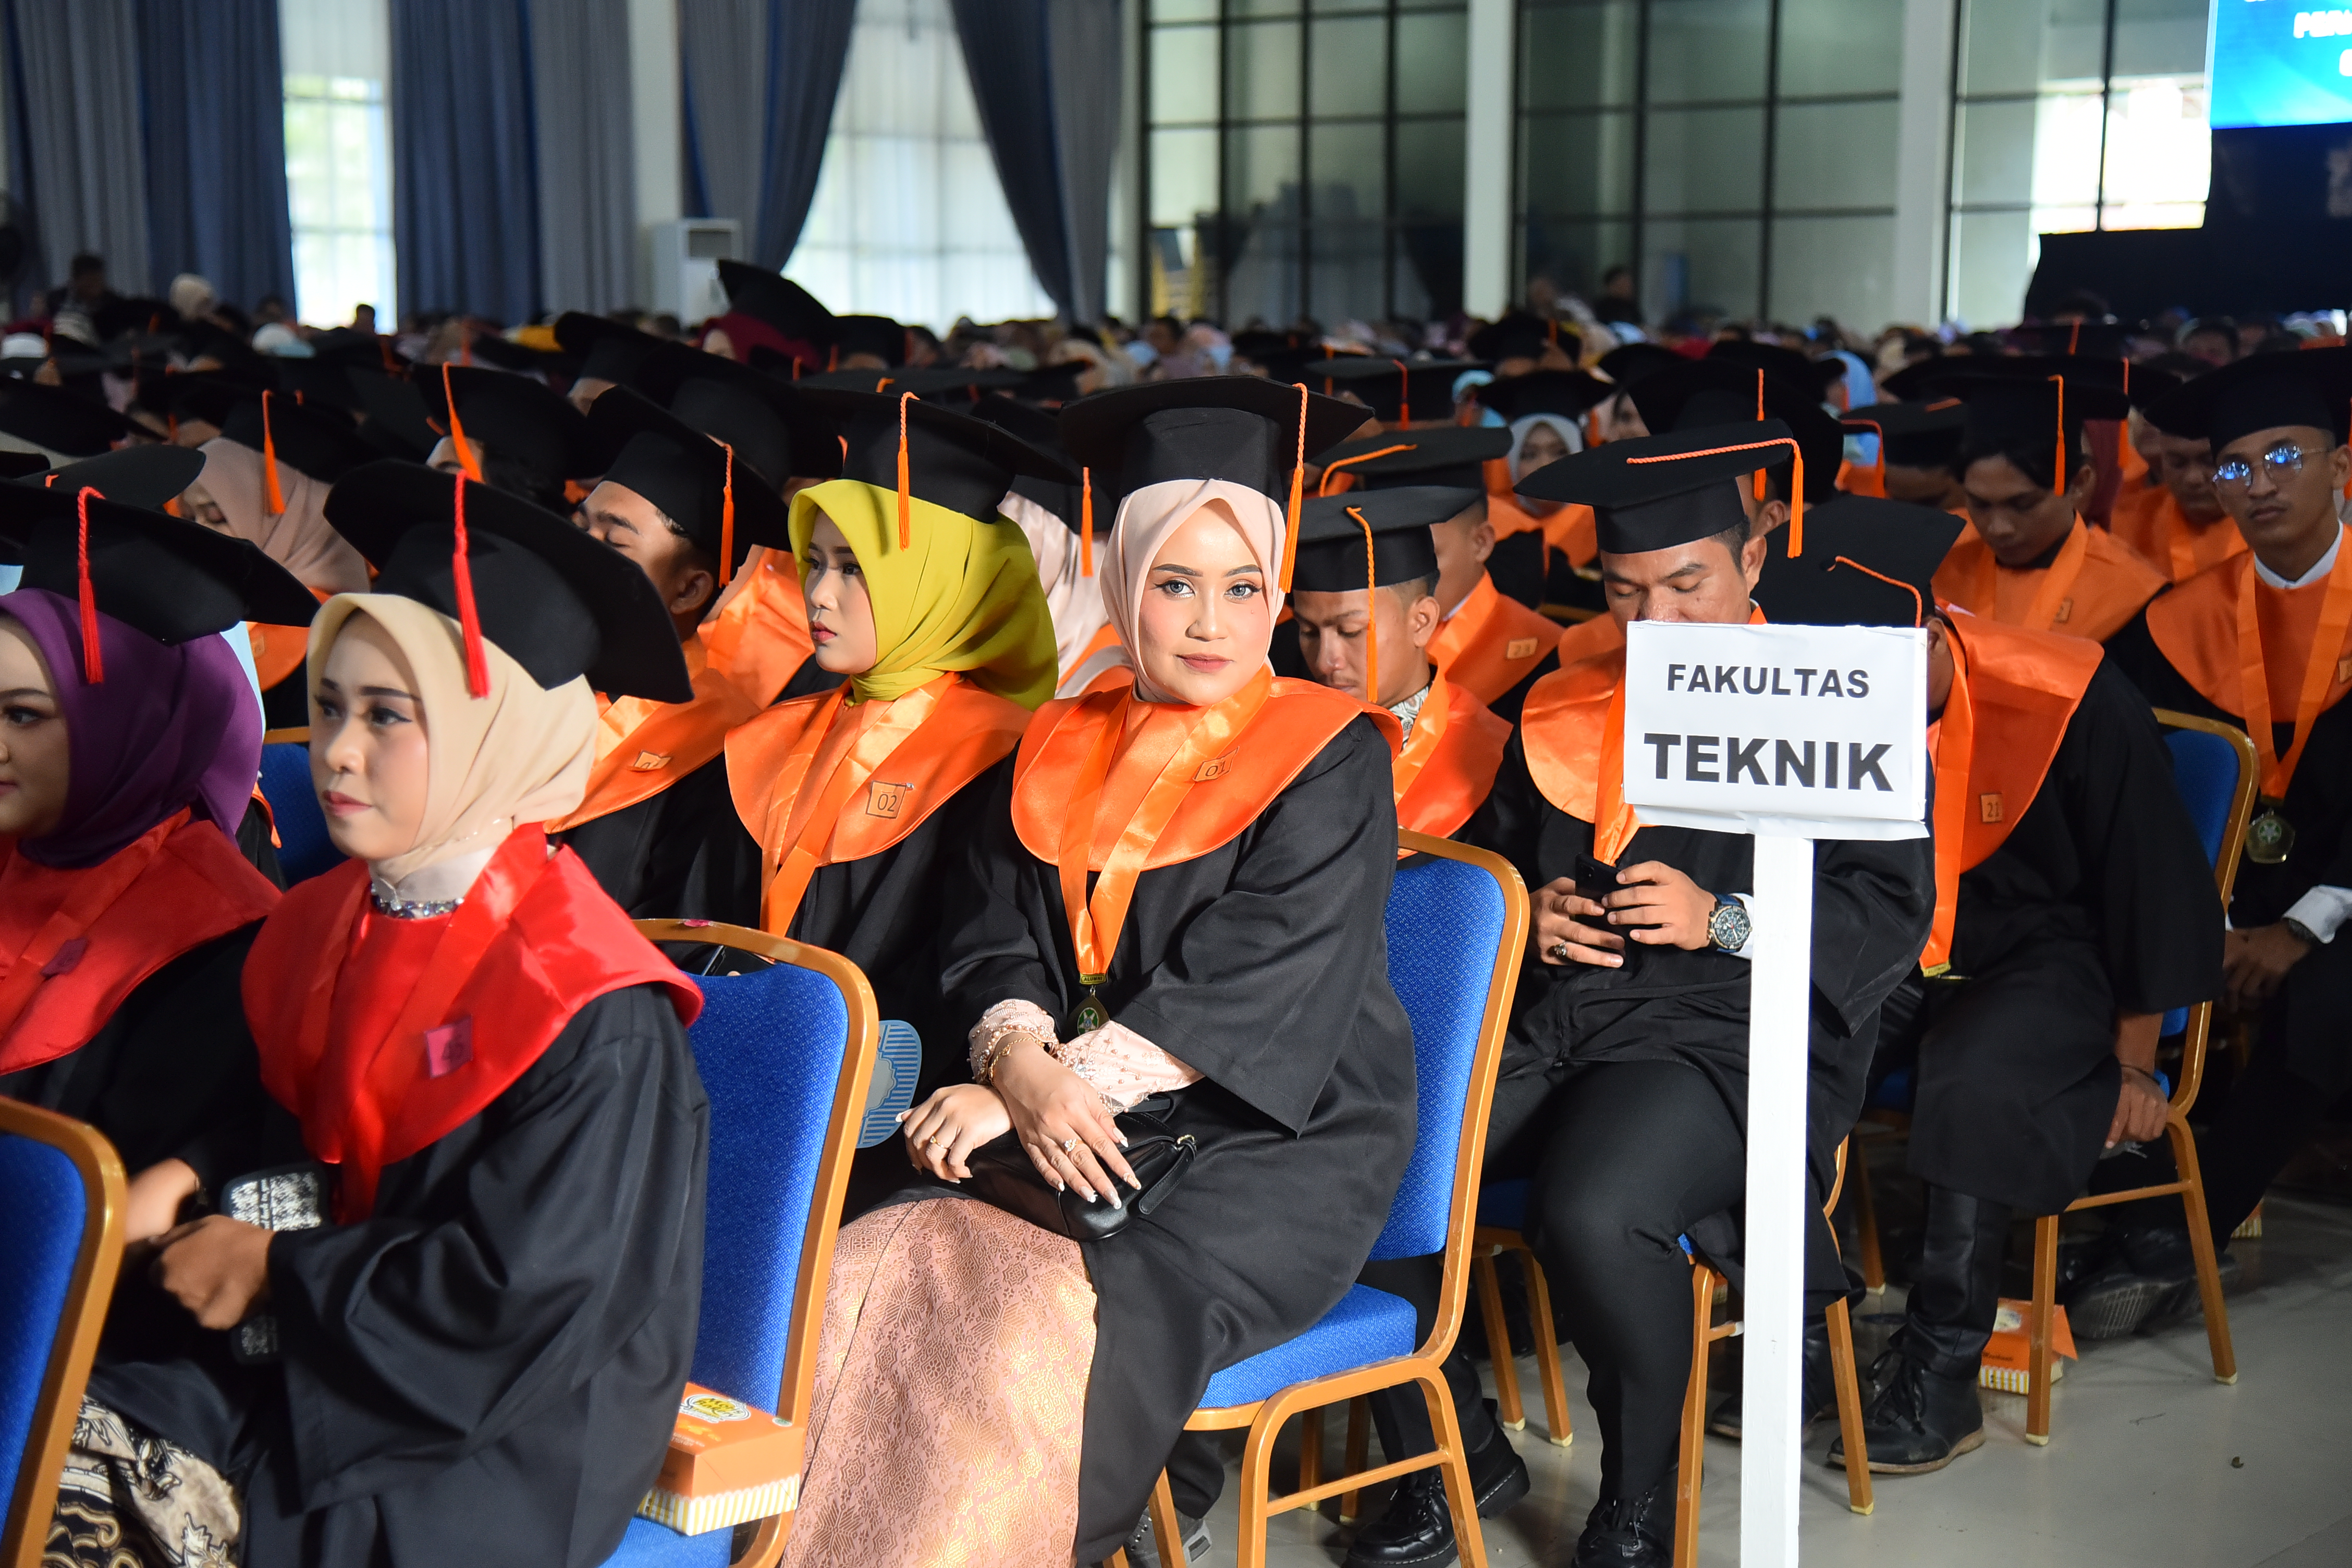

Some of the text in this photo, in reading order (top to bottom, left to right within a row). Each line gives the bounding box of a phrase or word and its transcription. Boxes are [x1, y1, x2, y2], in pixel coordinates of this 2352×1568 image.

[1667, 664, 1869, 699] FAKULTAS
[1205, 761, 1226, 777] 01
[1644, 733, 1895, 792] TEKNIK
[877, 793, 897, 812] 02
[1987, 802, 1999, 817] 21
